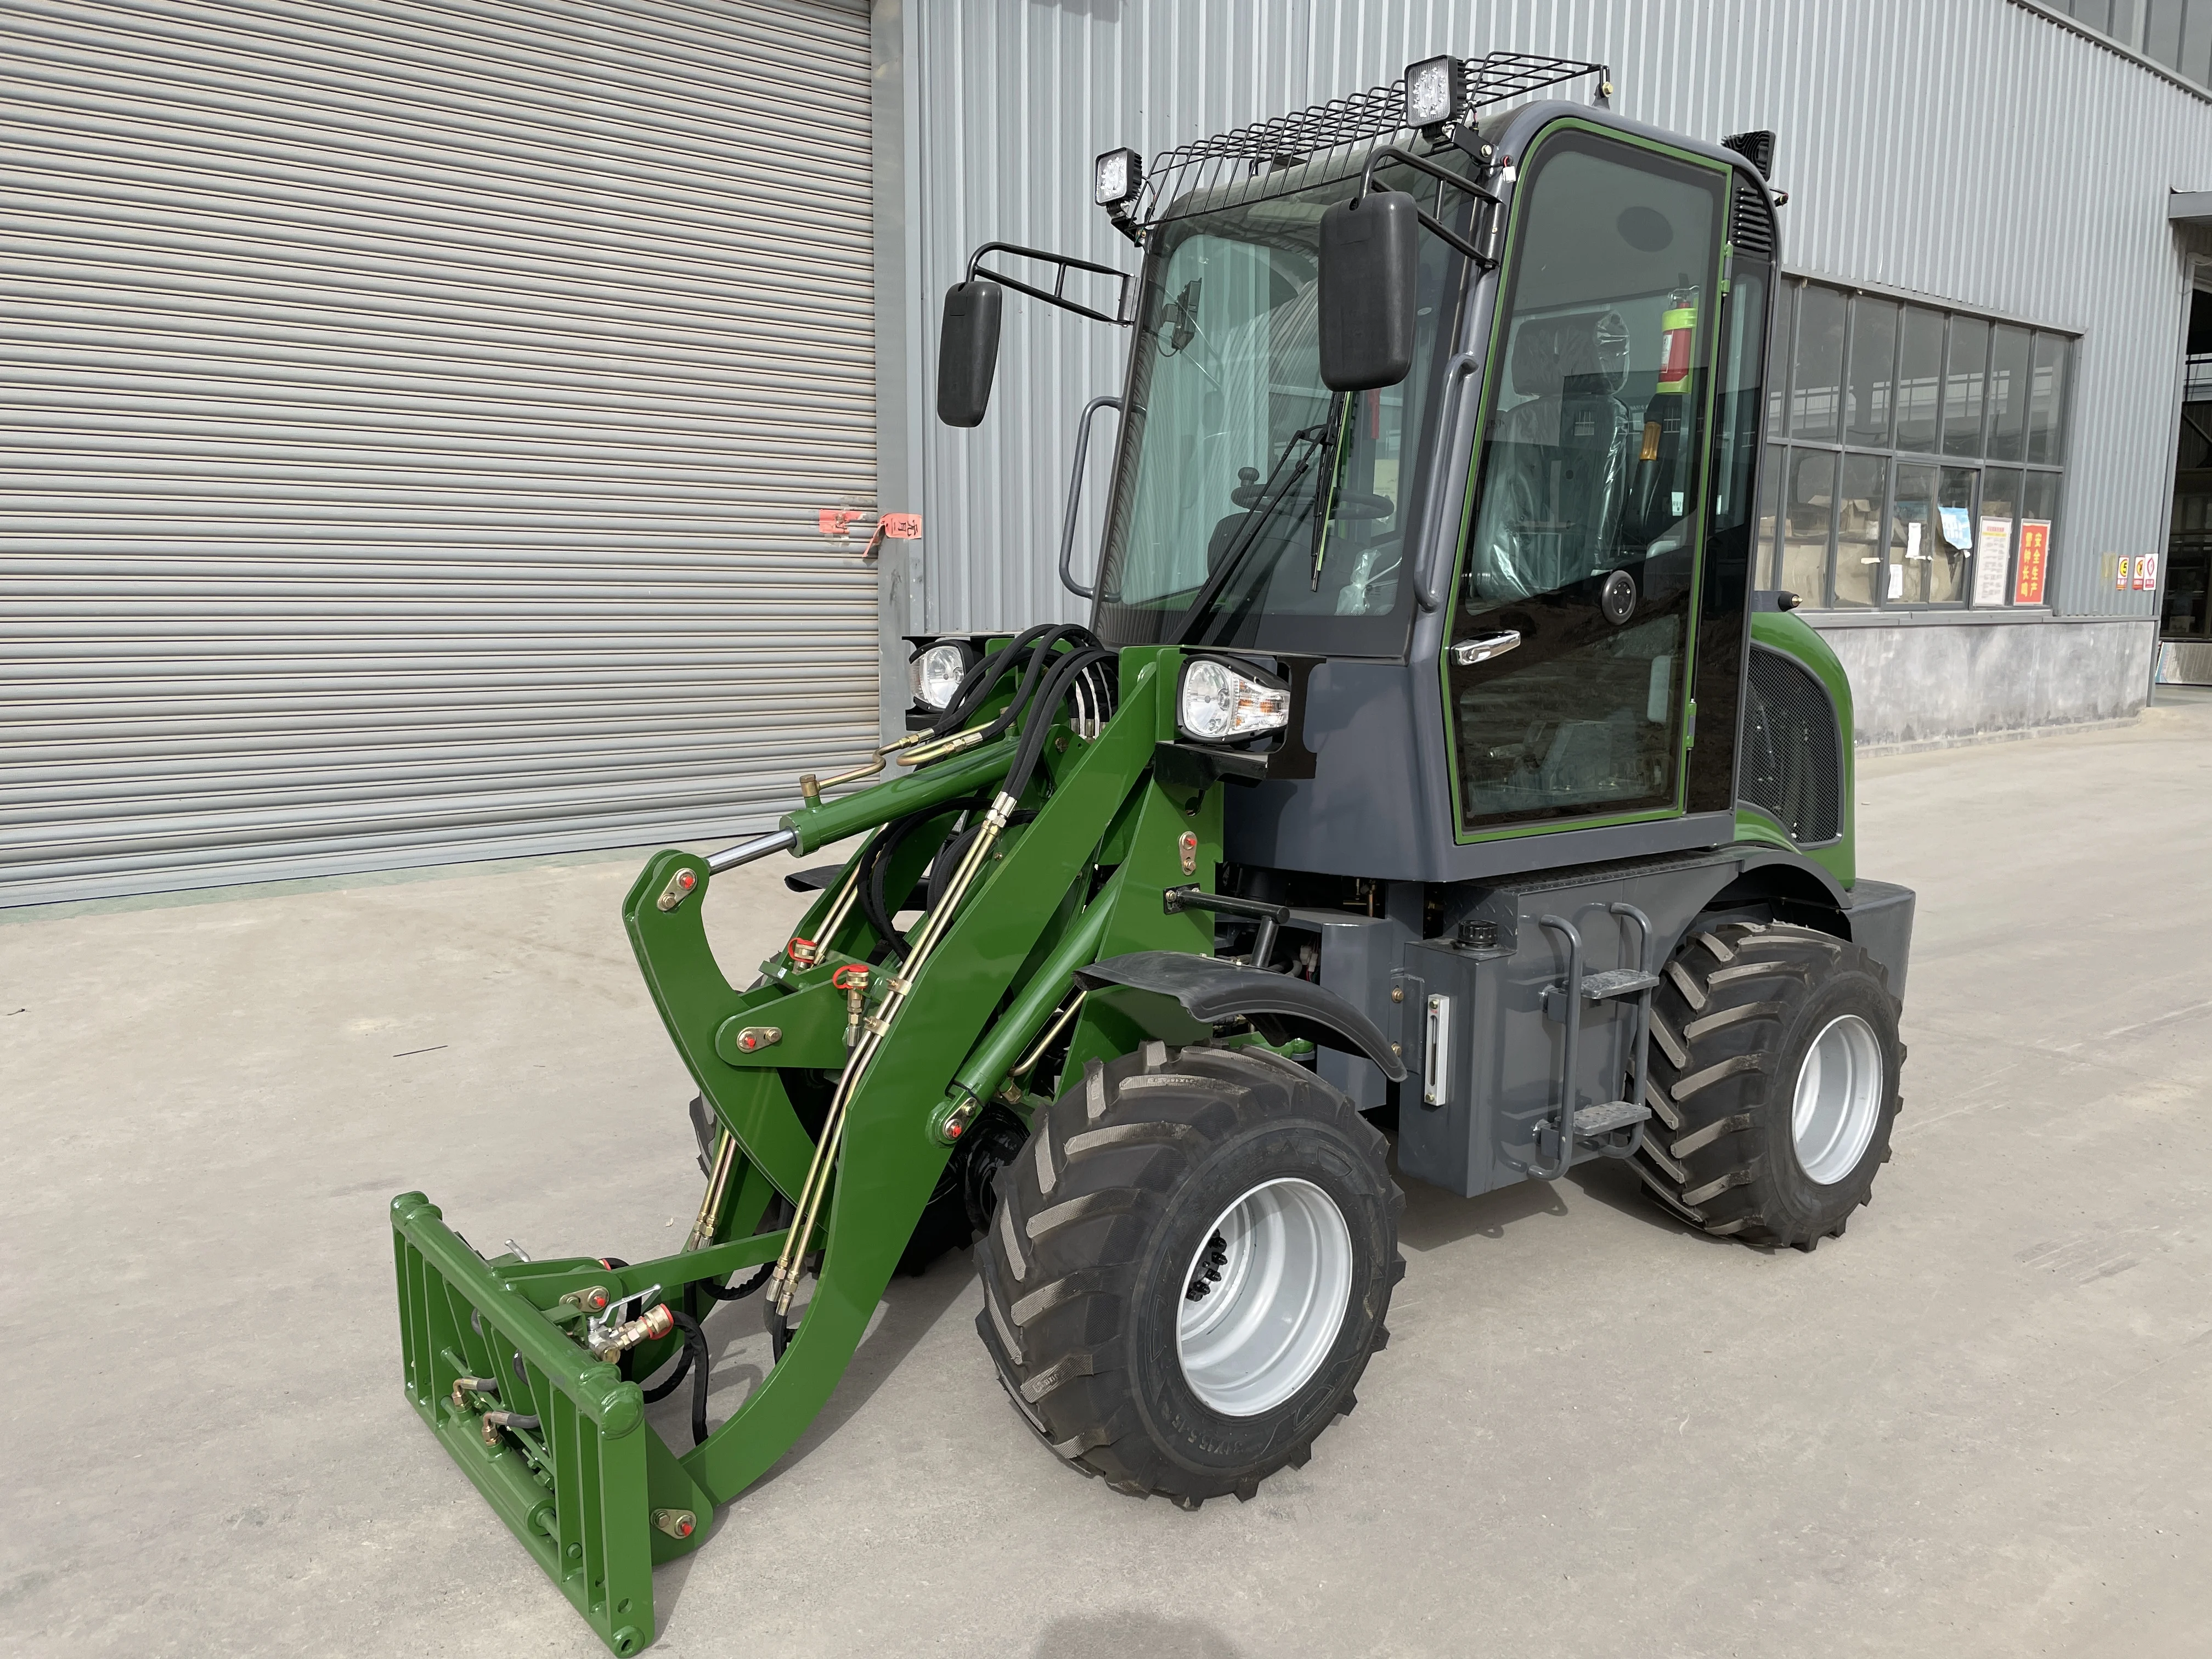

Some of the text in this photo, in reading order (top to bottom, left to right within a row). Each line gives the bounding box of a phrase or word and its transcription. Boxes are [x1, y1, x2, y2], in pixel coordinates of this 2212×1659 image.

[883, 518, 918, 537] 元月二
[2021, 532, 2033, 597] 警钟长鸣
[2030, 532, 2042, 597] 安全生产
